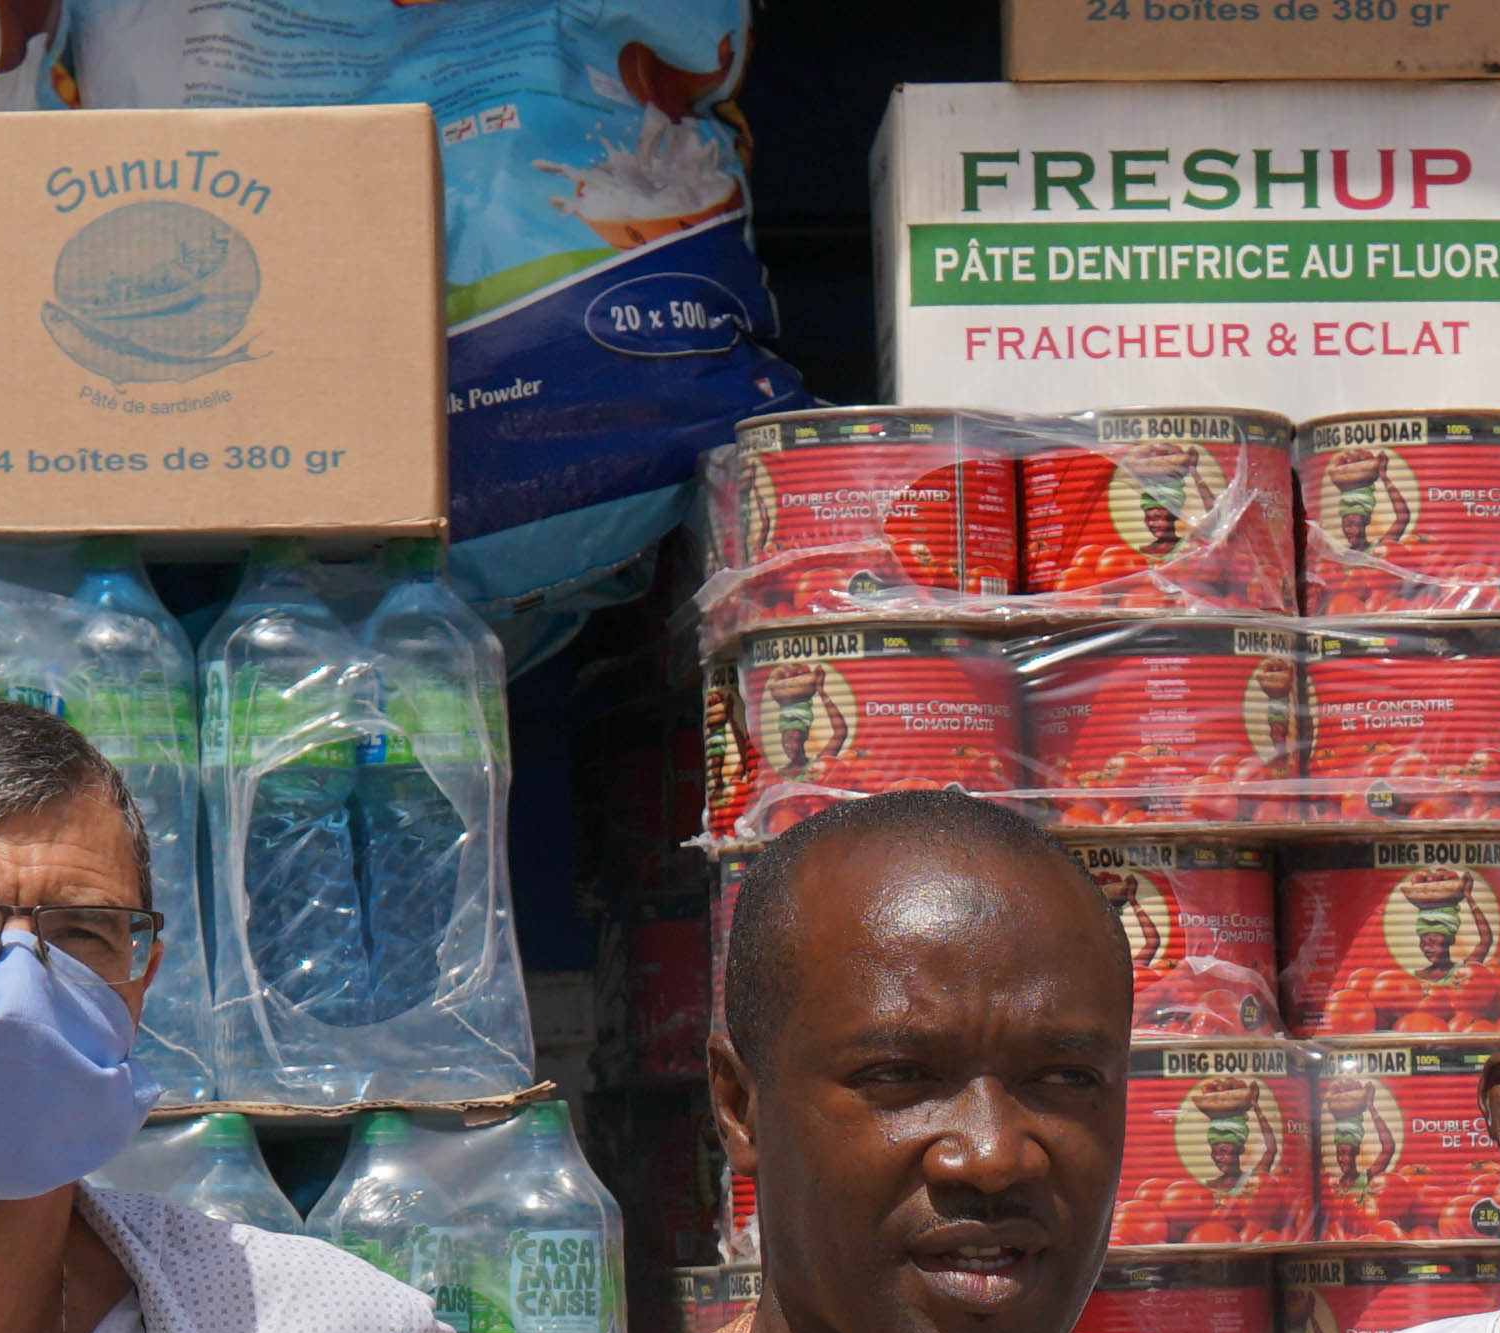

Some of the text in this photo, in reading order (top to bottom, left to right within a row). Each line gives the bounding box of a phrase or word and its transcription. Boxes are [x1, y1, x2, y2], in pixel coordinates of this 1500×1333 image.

[1086, 0, 1130, 22] 24
[1278, 0, 1319, 22] de
[1332, 0, 1401, 23] 380
[1409, 4, 1451, 27] gr
[46, 151, 271, 214] SunuTon
[961, 148, 1474, 211] FRESHUP
[935, 238, 1499, 283] PÂTE DENTIFRICE AU FLUOR
[611, 302, 706, 331] 20 x 500
[966, 322, 1469, 361] FRAICHEUR & ECLAT
[122, 398, 143, 413] de
[150, 387, 233, 413] sardinelle
[469, 378, 543, 409] Powder
[1102, 417, 1231, 440] DIEG BOU DIAR
[27, 446, 148, 472] boîtes
[163, 447, 209, 471] de
[223, 446, 291, 469] 380
[304, 448, 346, 474] gr
[1379, 844, 1419, 866] DIEG
[1423, 844, 1460, 866] BOU
[1167, 1052, 1285, 1074] DIEG BOU DIAR
[516, 1239, 595, 1264] CASA
[520, 1264, 596, 1289] MAN
[517, 1290, 596, 1316] CAISE
